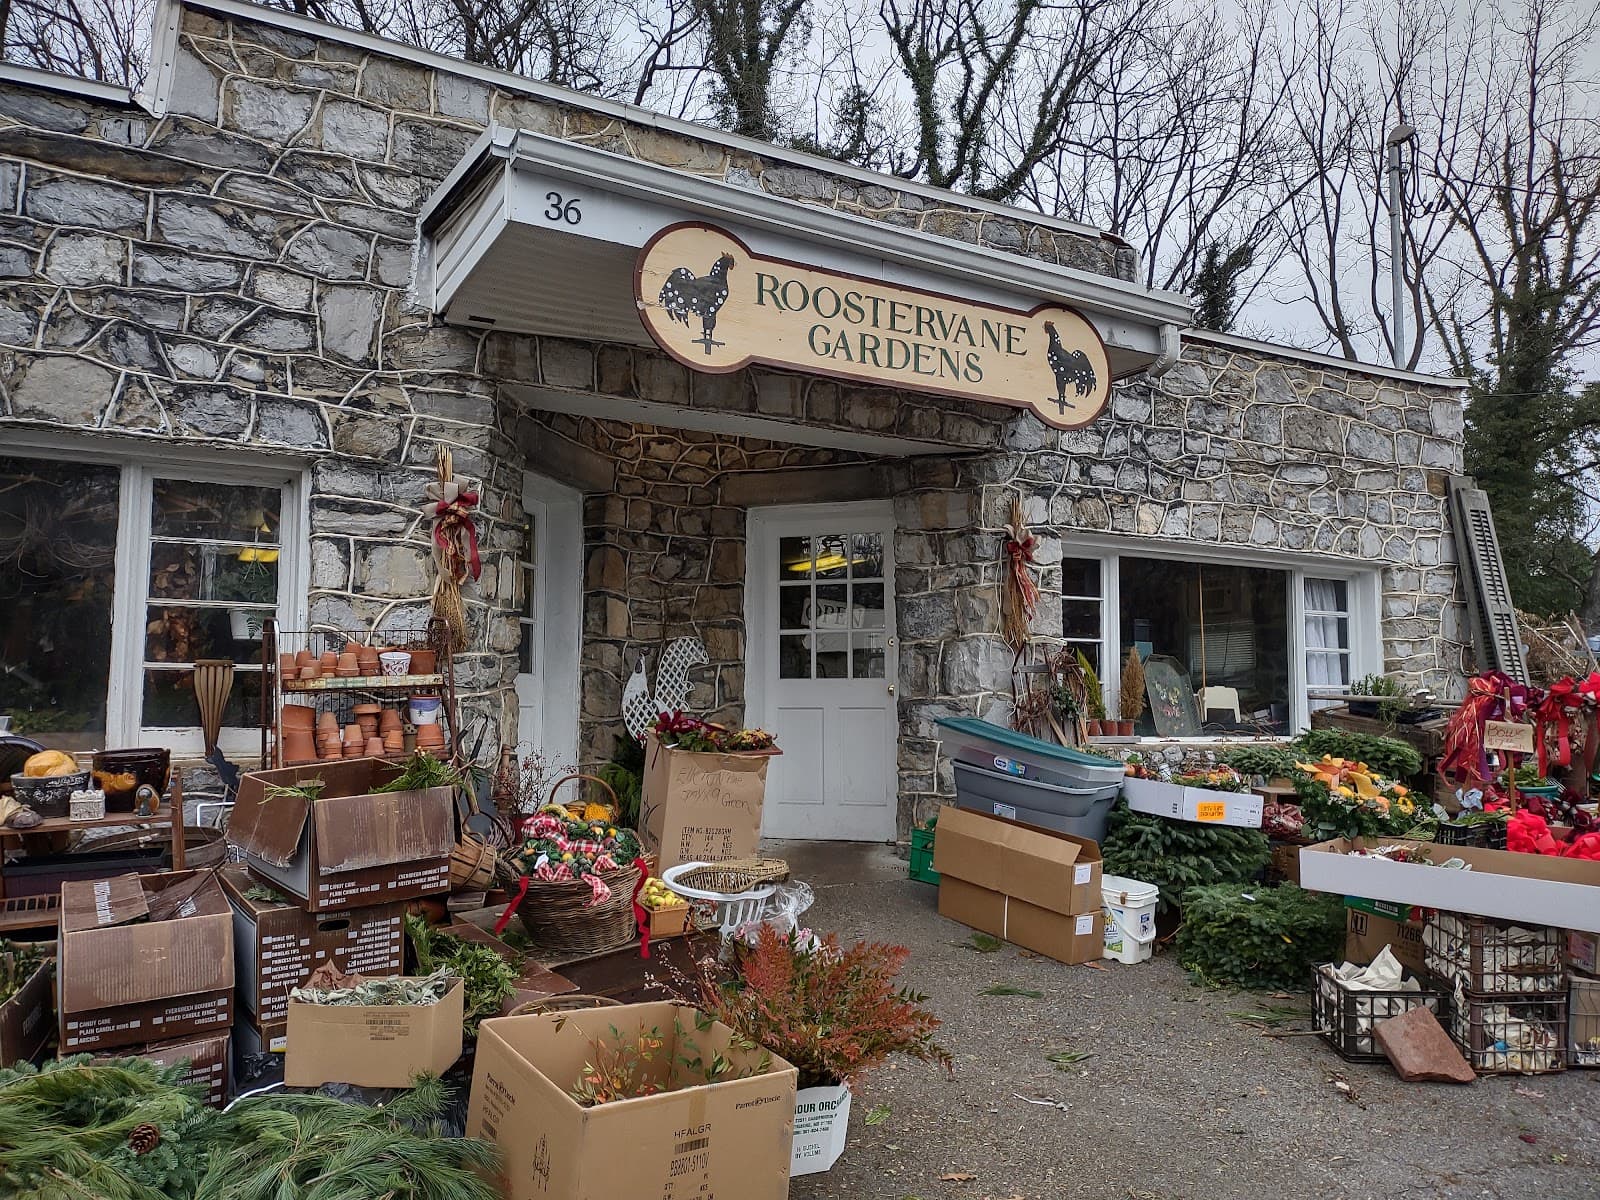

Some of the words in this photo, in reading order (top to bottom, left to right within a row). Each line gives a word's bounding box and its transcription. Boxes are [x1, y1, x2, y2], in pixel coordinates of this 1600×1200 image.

[545, 192, 582, 225] 36
[755, 272, 1028, 356] ROOSTERVANE
[808, 324, 984, 383] GARDENS
[79, 1020, 97, 1028] CANDY
[79, 1028, 95, 1036] PLAIN
[735, 1099, 755, 1110] Parrot
[764, 1095, 782, 1104] Uncle
[674, 1123, 712, 1139] HFALGR
